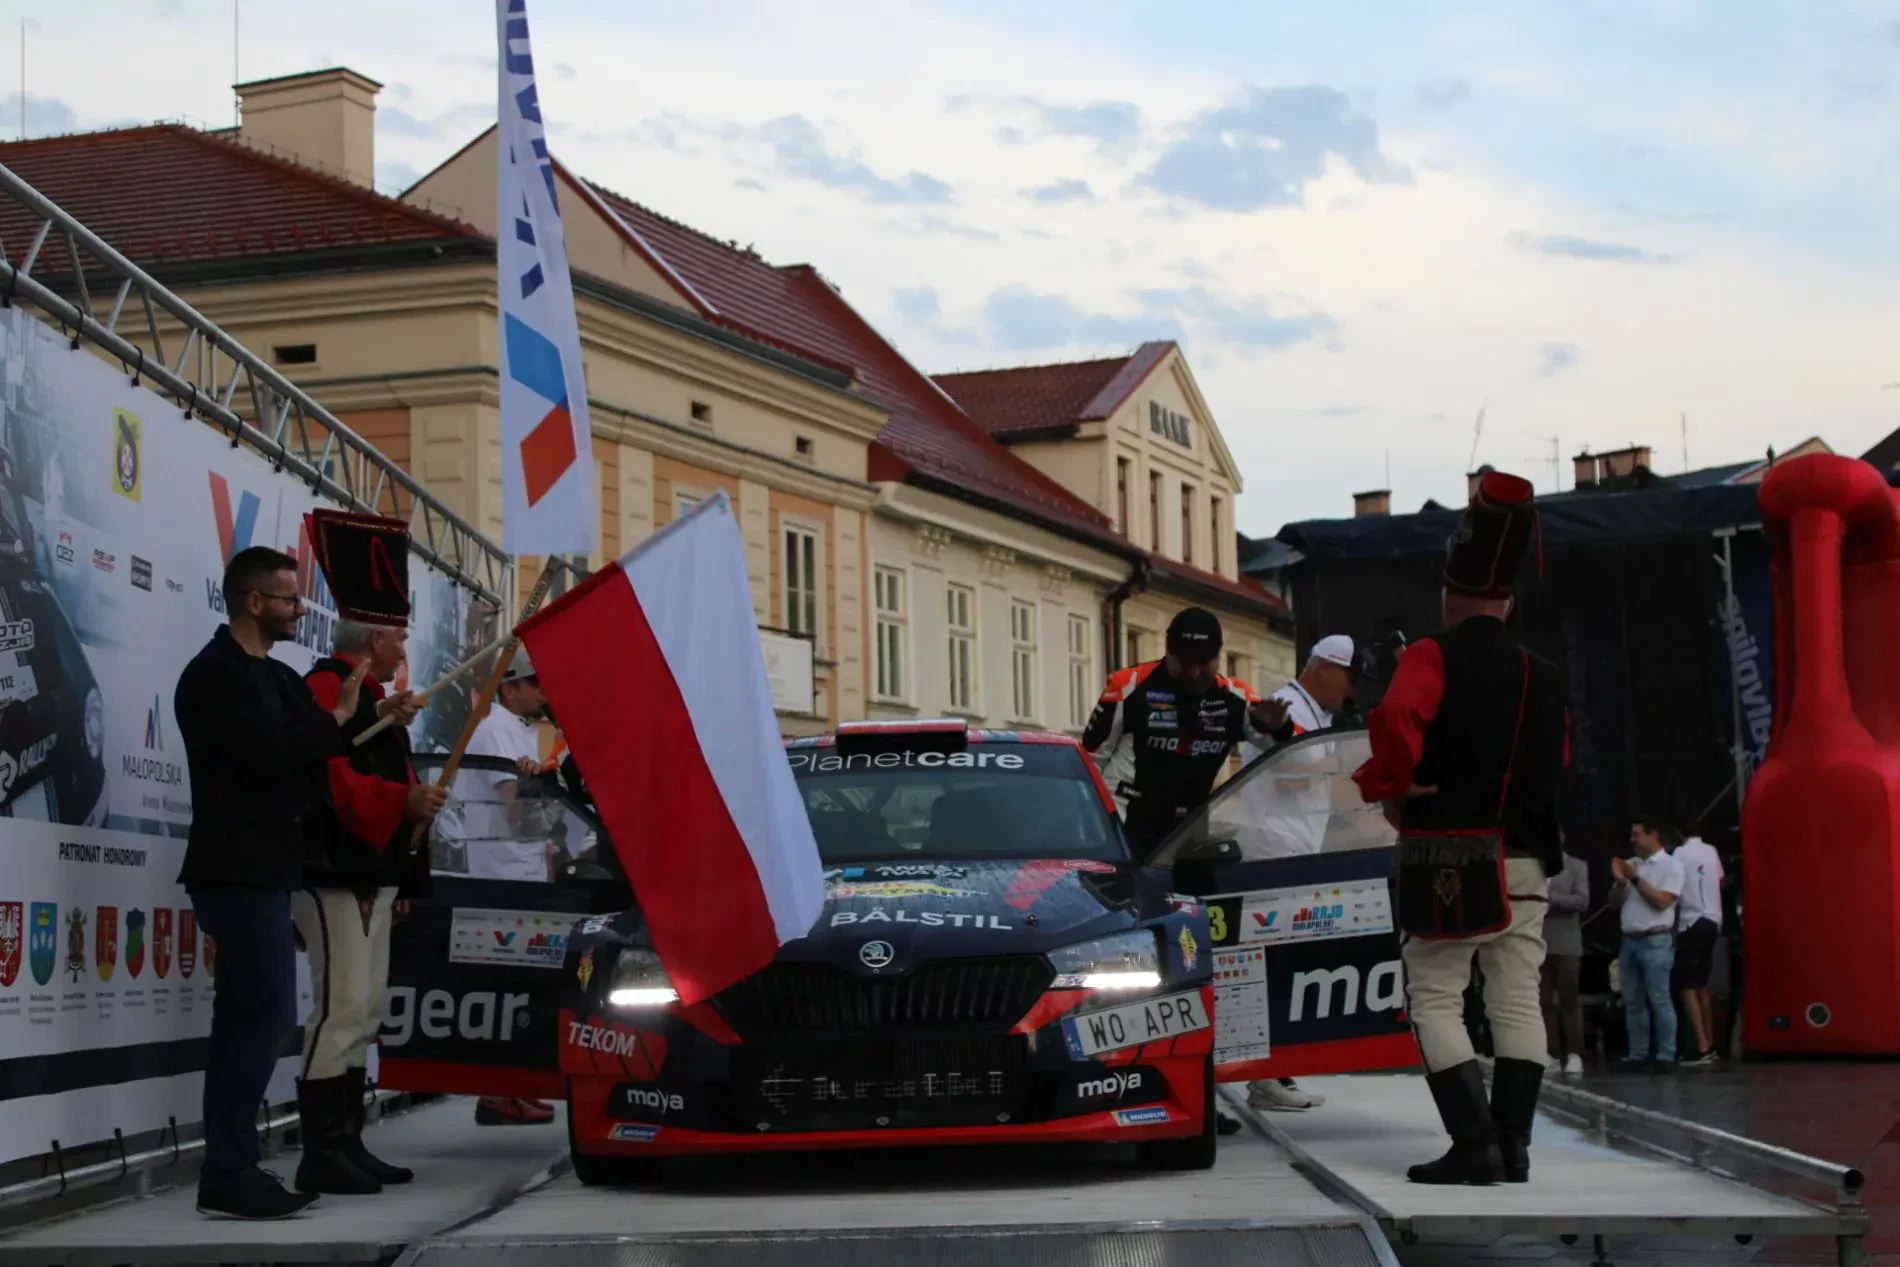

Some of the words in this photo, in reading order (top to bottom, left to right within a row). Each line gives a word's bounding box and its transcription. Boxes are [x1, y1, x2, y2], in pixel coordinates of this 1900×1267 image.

[59, 842, 101, 864] PATRONAT
[1144, 997, 1197, 1038] APR
[568, 1021, 636, 1059] TEKOM
[1077, 1072, 1143, 1099] moya
[626, 1087, 684, 1116] moya
